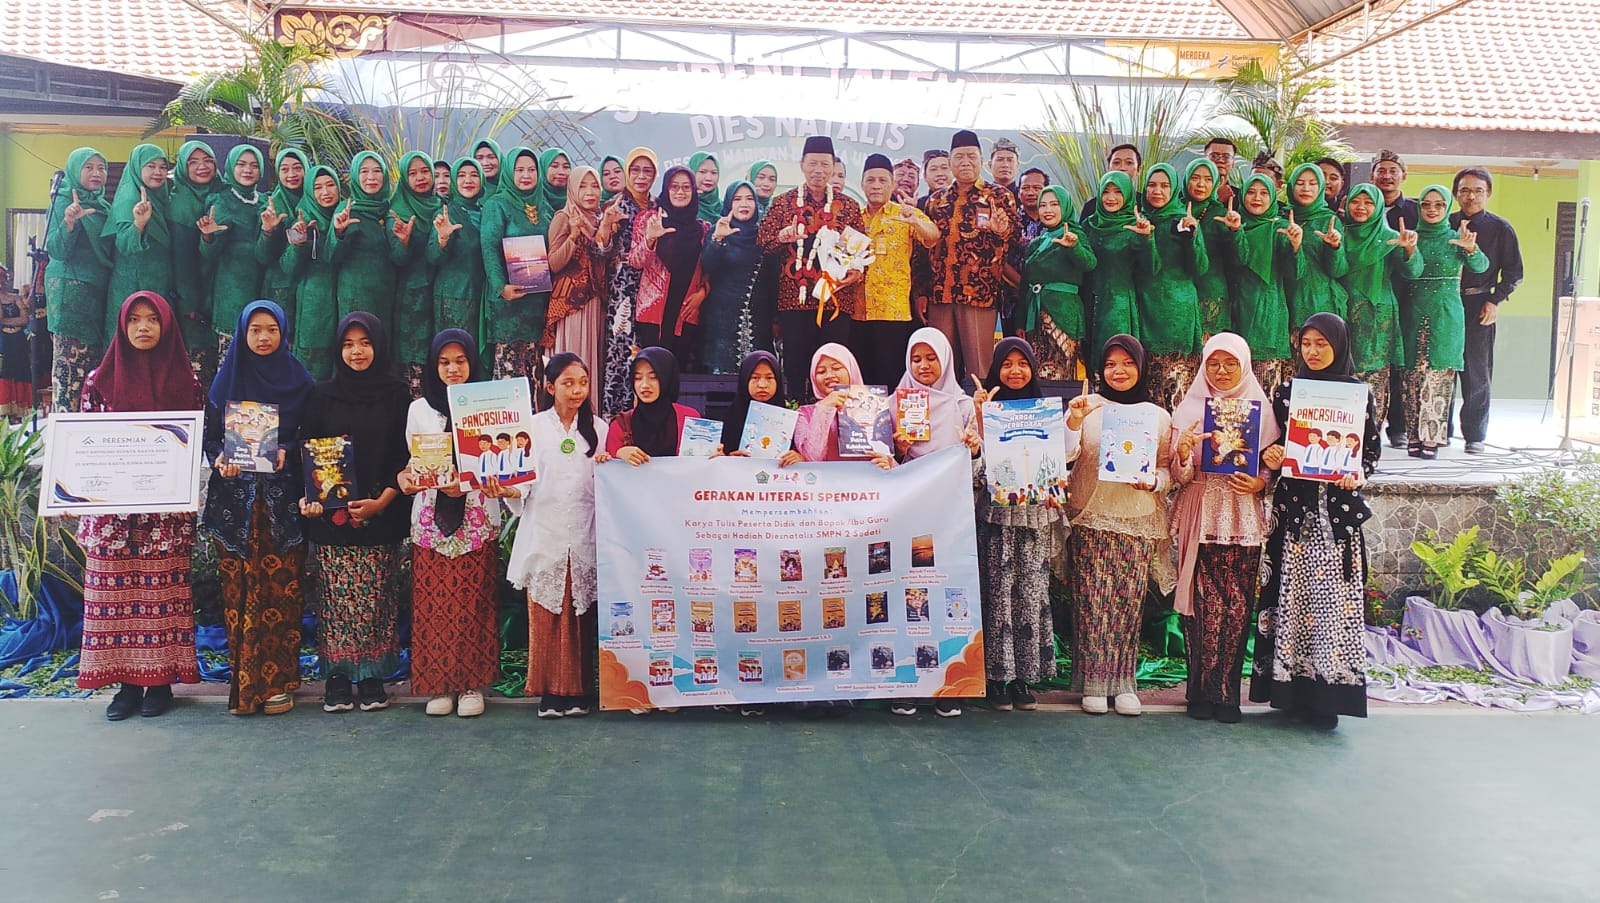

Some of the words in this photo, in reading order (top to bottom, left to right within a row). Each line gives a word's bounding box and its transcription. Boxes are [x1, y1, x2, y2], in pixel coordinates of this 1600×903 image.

[1180, 50, 1210, 60] MERDEKA
[689, 114, 765, 148] DIES
[462, 410, 520, 428] PANCASILAKU
[1296, 407, 1354, 425] PANCASILAKU
[694, 490, 755, 502] GERAKAN
[759, 491, 814, 502] LITERASI
[817, 492, 881, 502] SPENDATI
[684, 519, 714, 528] Karya
[716, 519, 736, 528] Tulis
[737, 519, 772, 528] Peserta
[774, 519, 796, 528] Didik
[799, 519, 816, 527] dan
[867, 516, 889, 524] Guru
[695, 531, 730, 540] Sebagai
[732, 531, 763, 540] Hadiah
[765, 531, 814, 540] Diesnatalis
[816, 530, 842, 538] SMPN
[844, 530, 851, 538] 2
